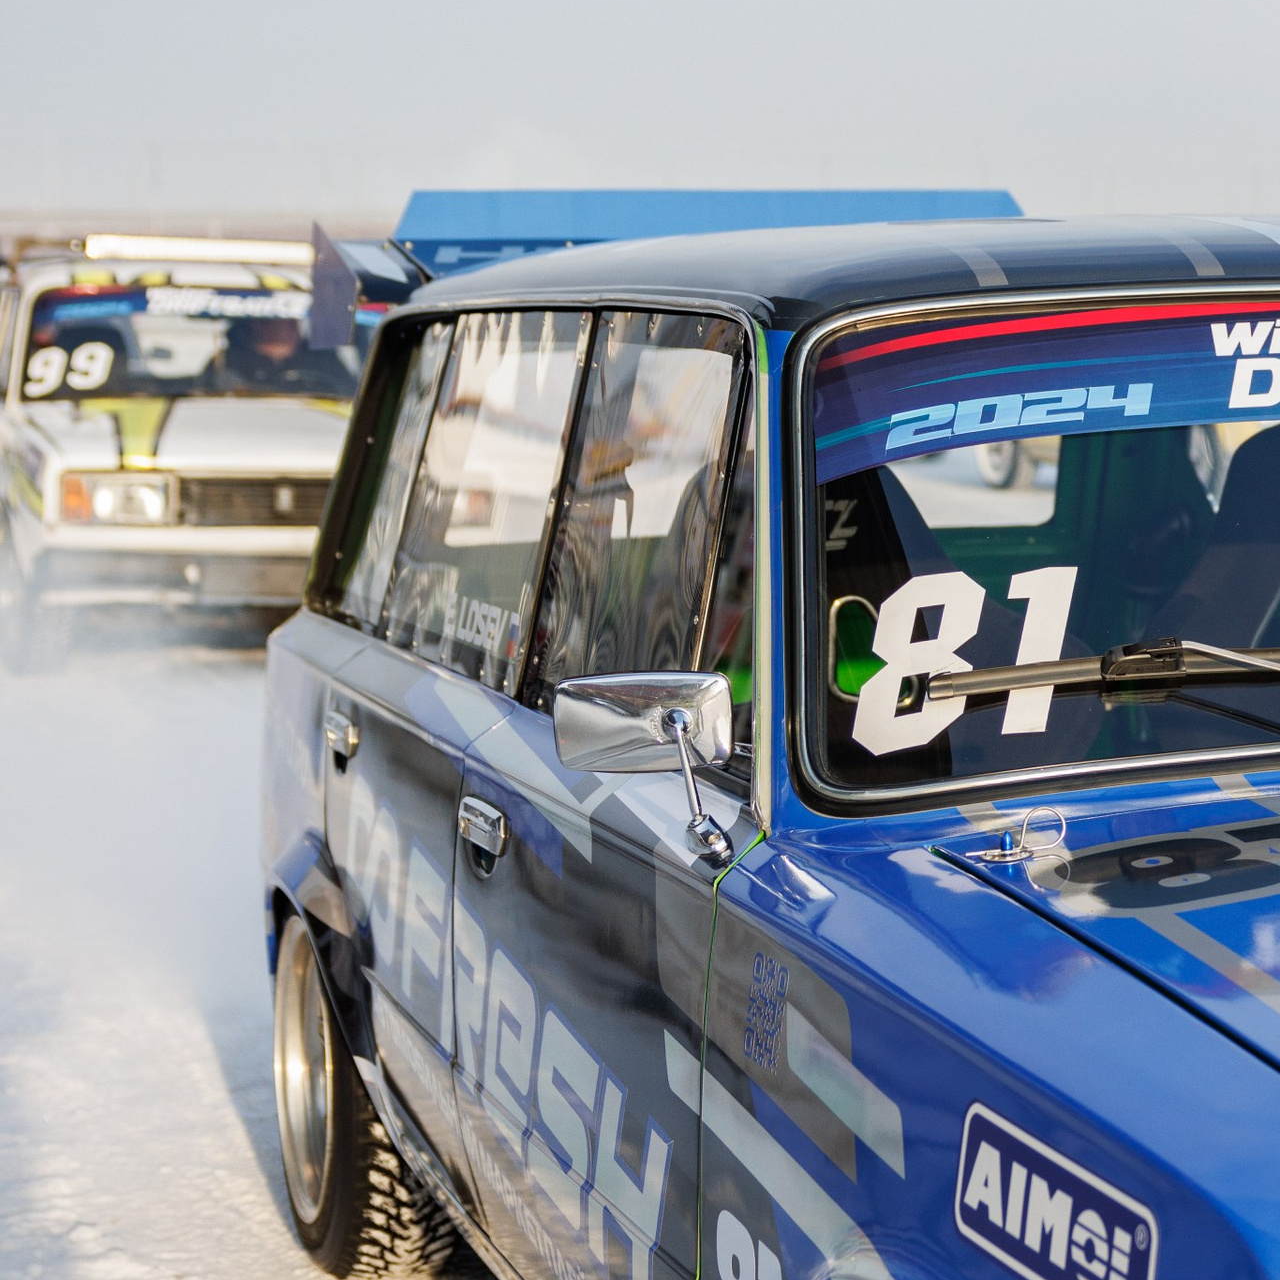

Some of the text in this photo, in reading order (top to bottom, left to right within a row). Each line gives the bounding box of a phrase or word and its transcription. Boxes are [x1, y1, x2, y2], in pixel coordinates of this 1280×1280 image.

[24, 341, 114, 398] 99
[886, 383, 1154, 450] 2024
[456, 596, 509, 654] LOSEV
[852, 566, 1078, 756] 81
